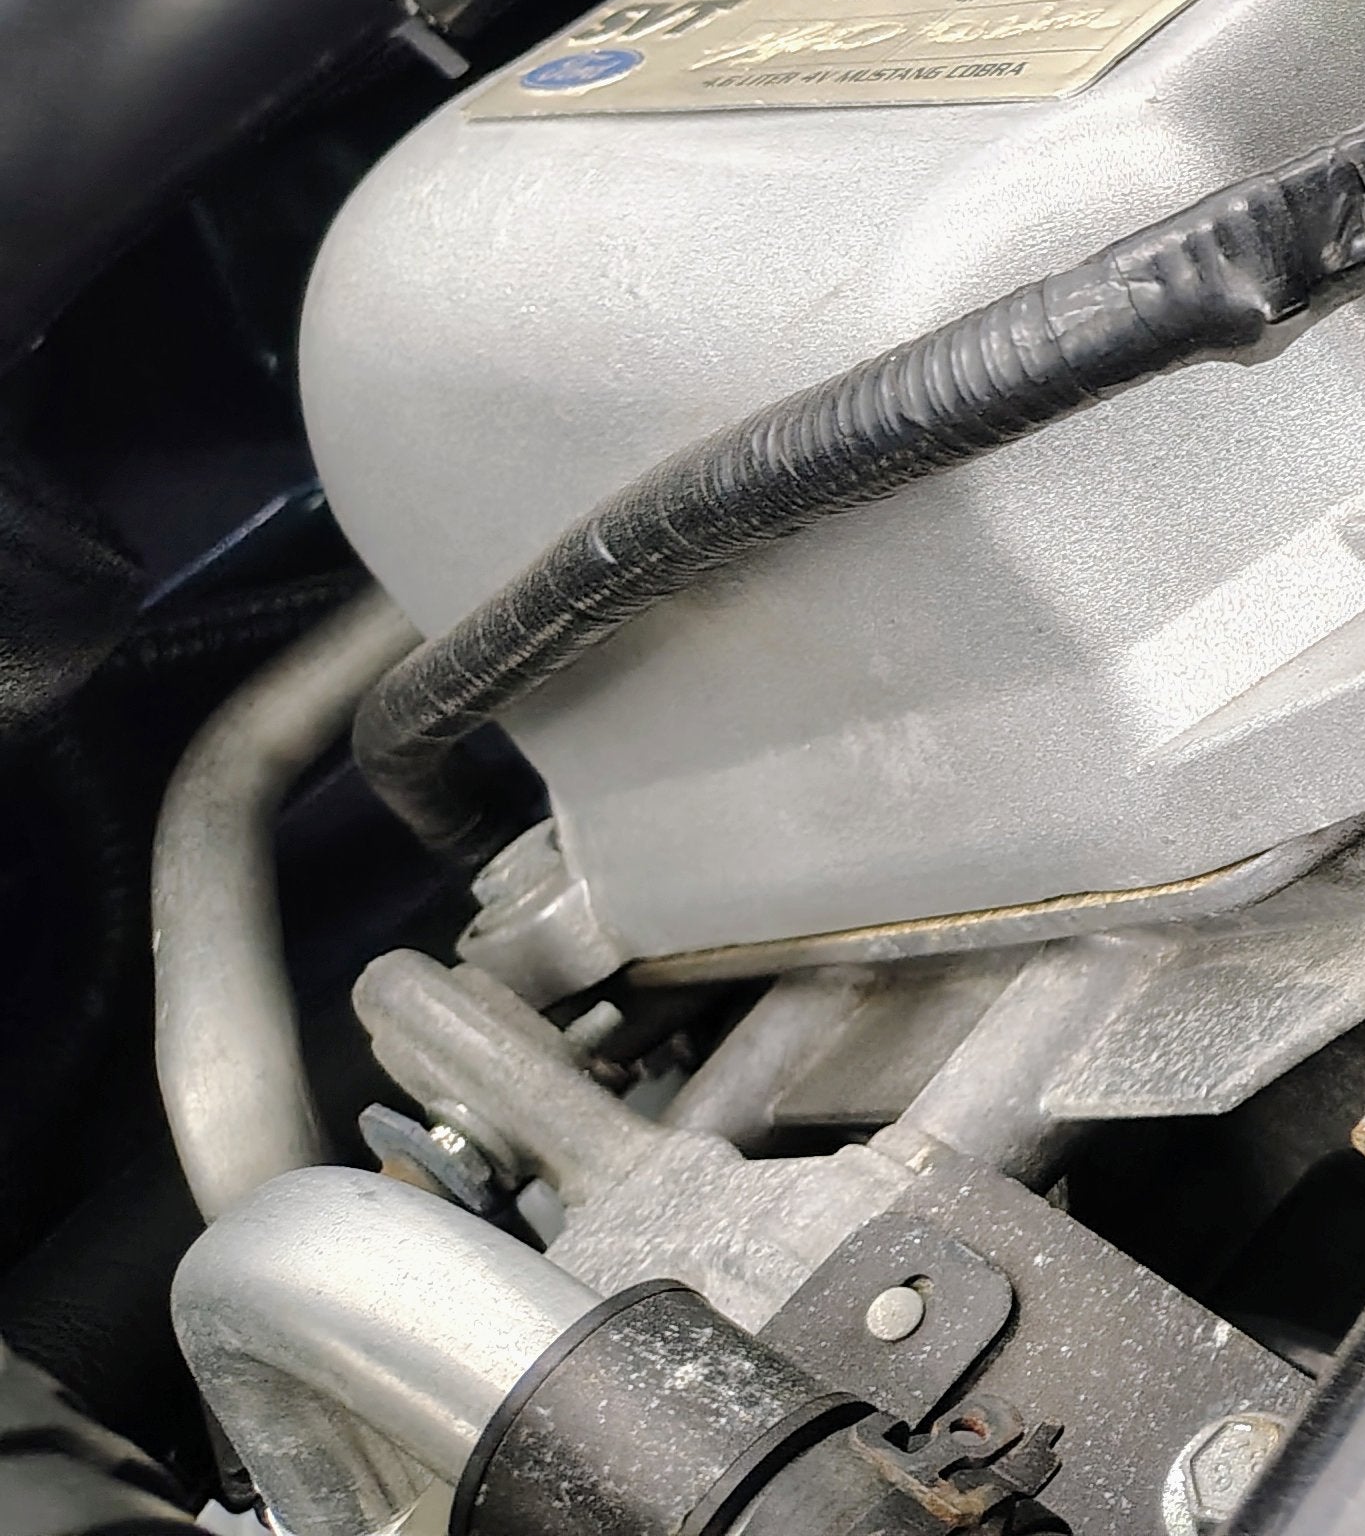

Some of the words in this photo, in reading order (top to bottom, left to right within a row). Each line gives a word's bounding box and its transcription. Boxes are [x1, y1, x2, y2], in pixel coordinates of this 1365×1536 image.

[737, 72, 800, 87] LITER
[837, 66, 946, 83] MUSTANG
[946, 62, 1028, 79] COBRA
